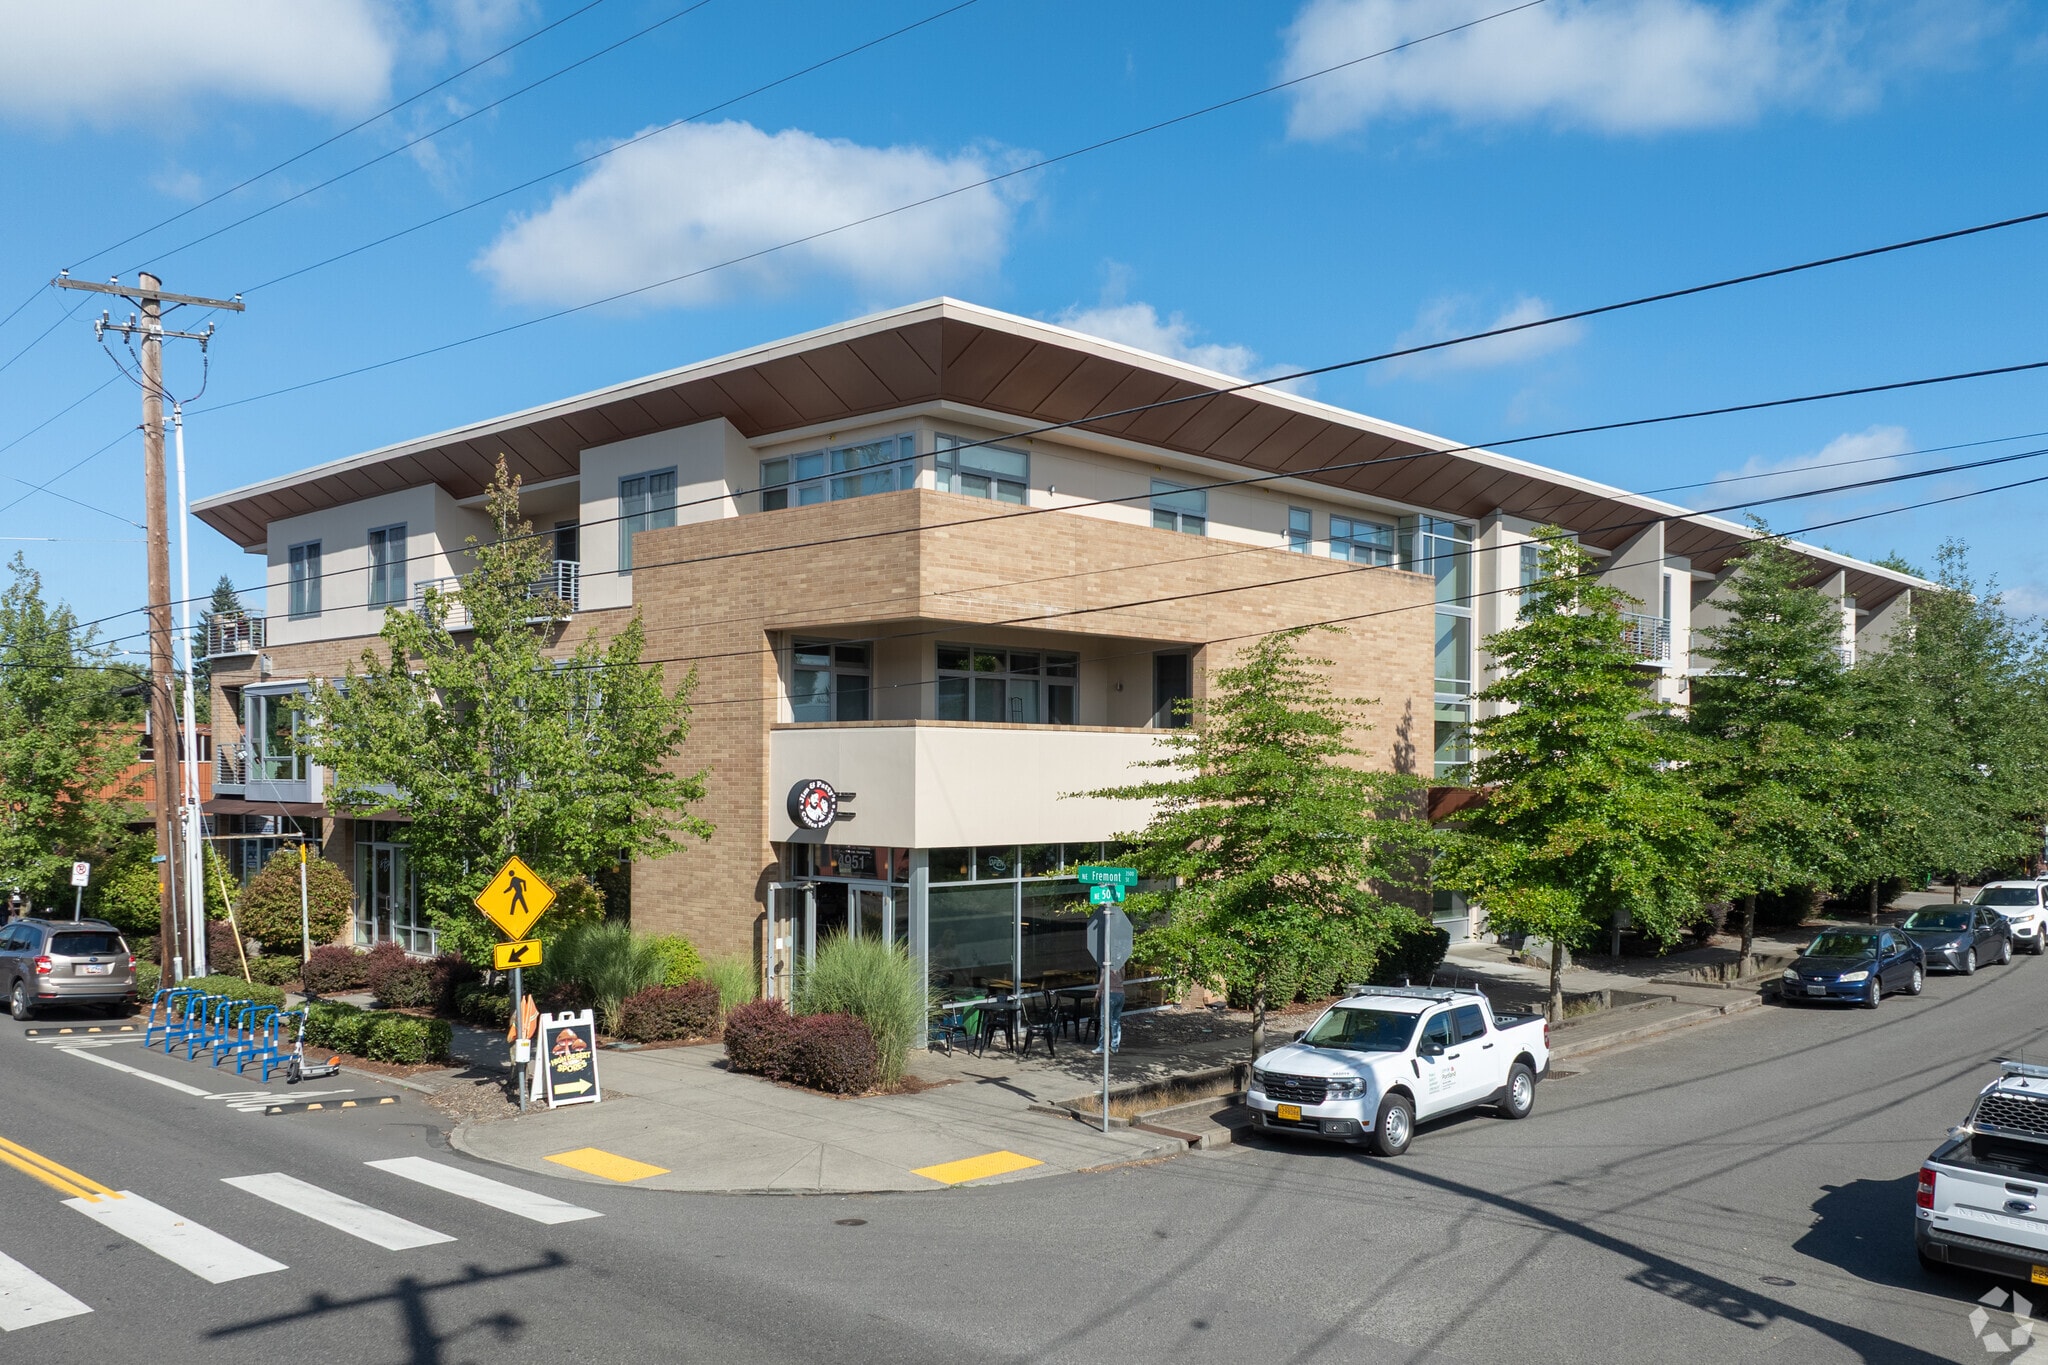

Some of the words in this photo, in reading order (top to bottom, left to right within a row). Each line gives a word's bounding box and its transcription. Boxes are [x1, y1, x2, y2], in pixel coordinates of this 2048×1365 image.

[799, 787, 810, 804] Jim
[809, 781, 816, 789] &
[816, 780, 836, 802] Patty's
[801, 811, 818, 828] Coffee
[838, 853, 864, 870] 4951
[989, 858, 1004, 868] OPEN
[1092, 870, 1121, 882] Fremont
[550, 1055, 567, 1067] HIGH
[567, 1051, 591, 1061] DESERT
[556, 1060, 588, 1073] SPORES
